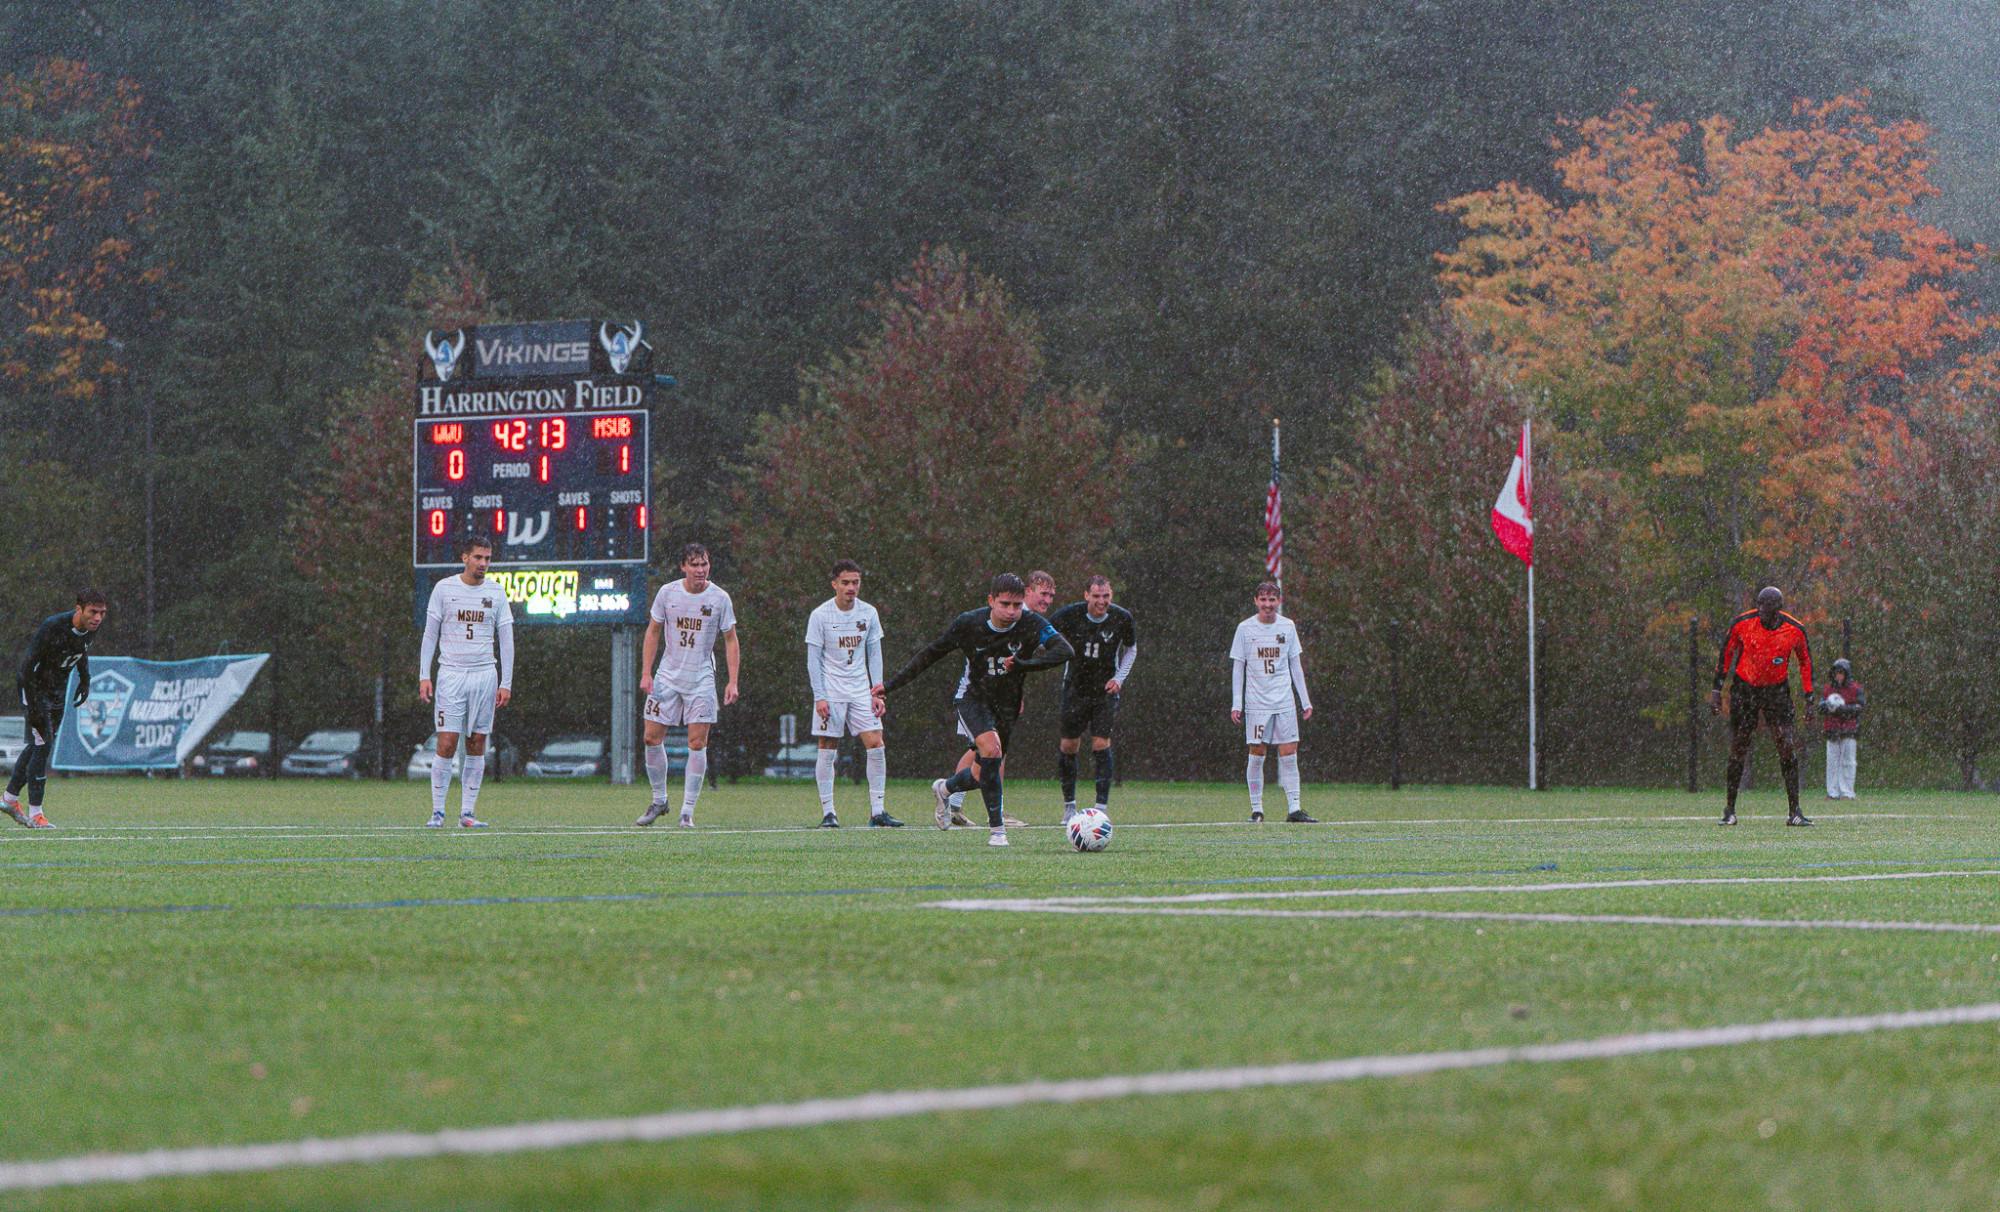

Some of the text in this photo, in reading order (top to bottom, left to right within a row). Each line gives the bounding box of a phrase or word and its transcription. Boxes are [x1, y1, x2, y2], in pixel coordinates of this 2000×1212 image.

[475, 339, 590, 366] VIKINGS
[420, 380, 642, 415] HARRINGTON FIELD
[433, 423, 463, 444] WWU
[494, 418, 566, 451] 42:13
[593, 417, 631, 438] MSUB
[448, 449, 465, 480] 0
[621, 444, 629, 473] 1
[492, 463, 530, 478] PERIOD
[540, 454, 549, 482] 1
[422, 496, 453, 510] SAVES
[472, 495, 503, 508] SHOTS
[558, 492, 591, 506] SAVES
[610, 490, 642, 504] SHOTS
[430, 509, 445, 536] 0
[457, 609, 485, 623] MSUB
[676, 617, 702, 631] MSUB
[466, 624, 474, 640] 5
[680, 631, 695, 648] 34
[1085, 642, 1100, 659] 11
[1257, 647, 1280, 659] MSUB
[1264, 659, 1275, 674] 15
[646, 699, 660, 716] 34
[437, 711, 445, 727] 5
[1254, 725, 1265, 740] 15
